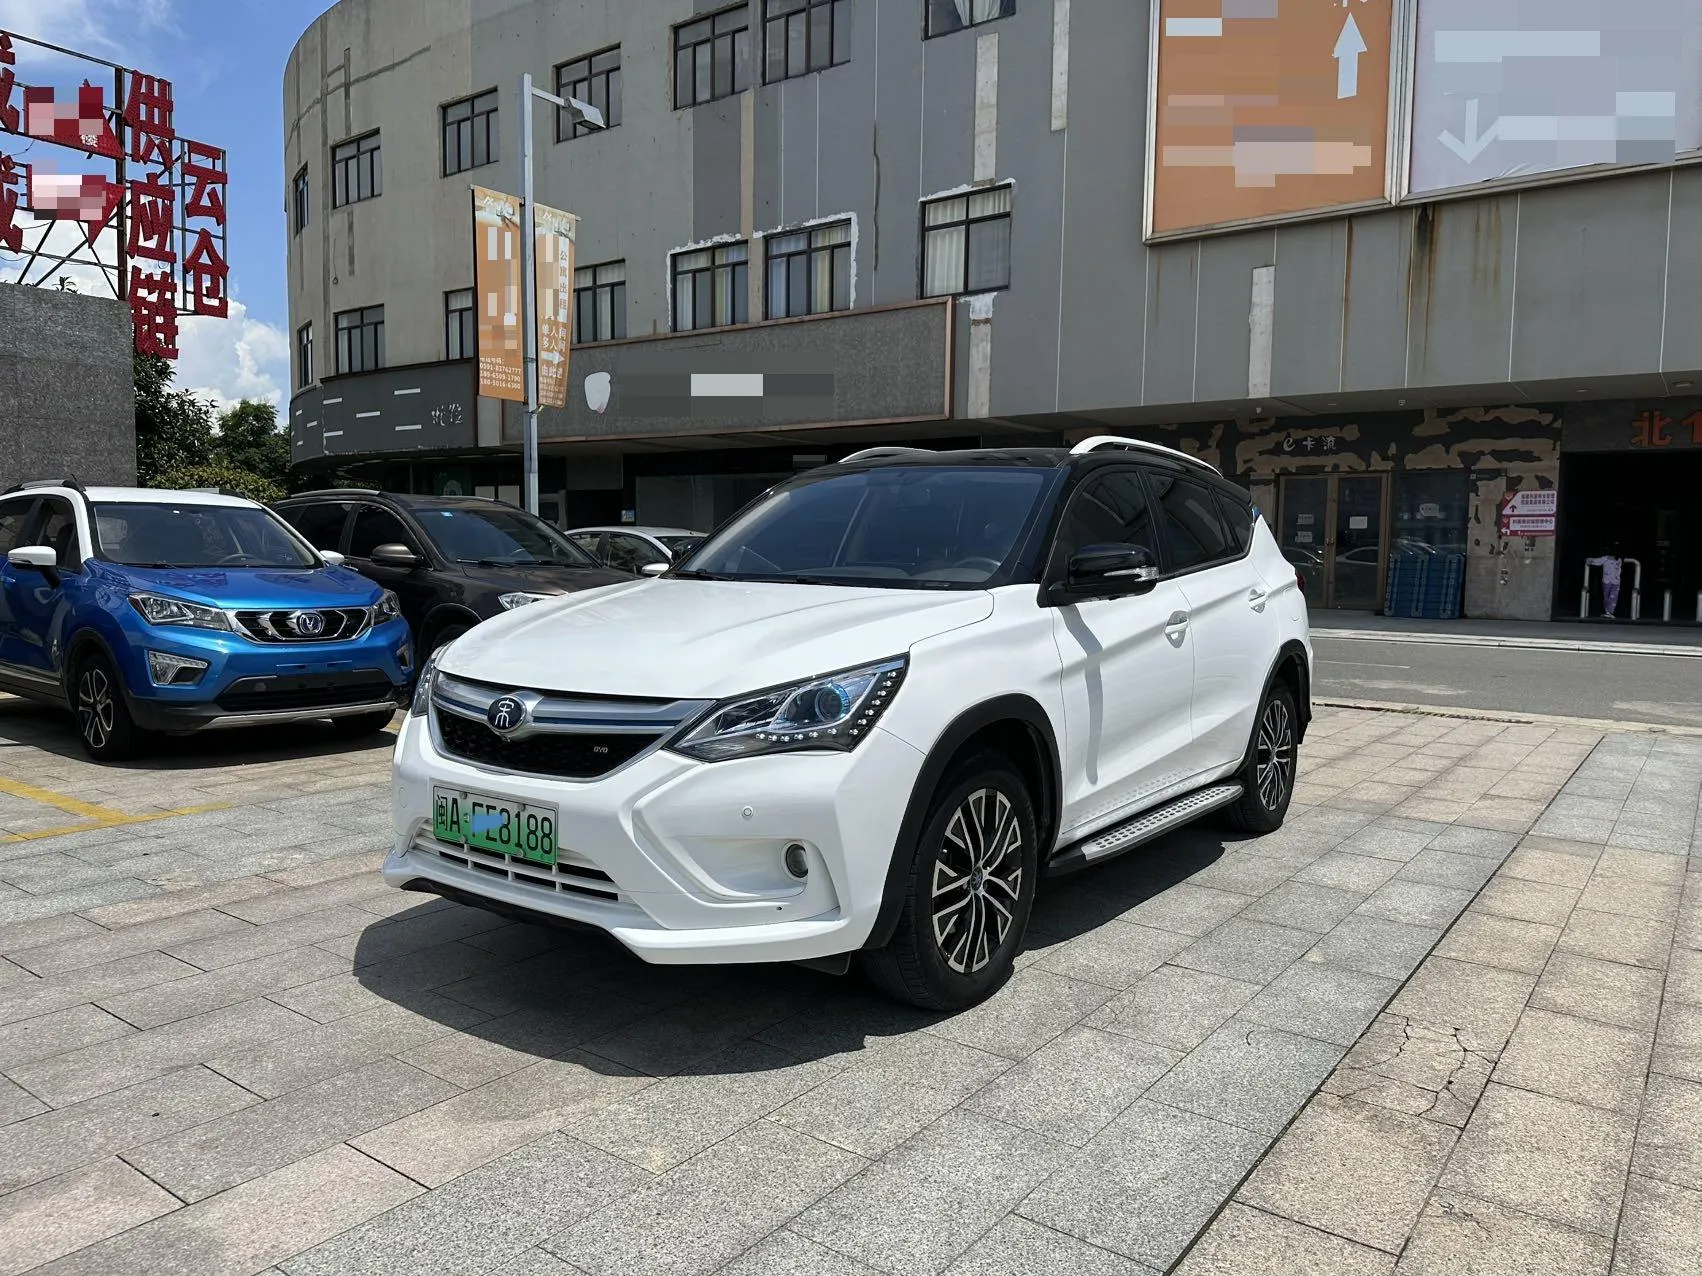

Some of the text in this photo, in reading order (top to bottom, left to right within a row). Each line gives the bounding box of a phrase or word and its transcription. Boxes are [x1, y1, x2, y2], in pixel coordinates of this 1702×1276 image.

[123, 70, 179, 360] 供应链
[182, 140, 230, 319] 云仓
